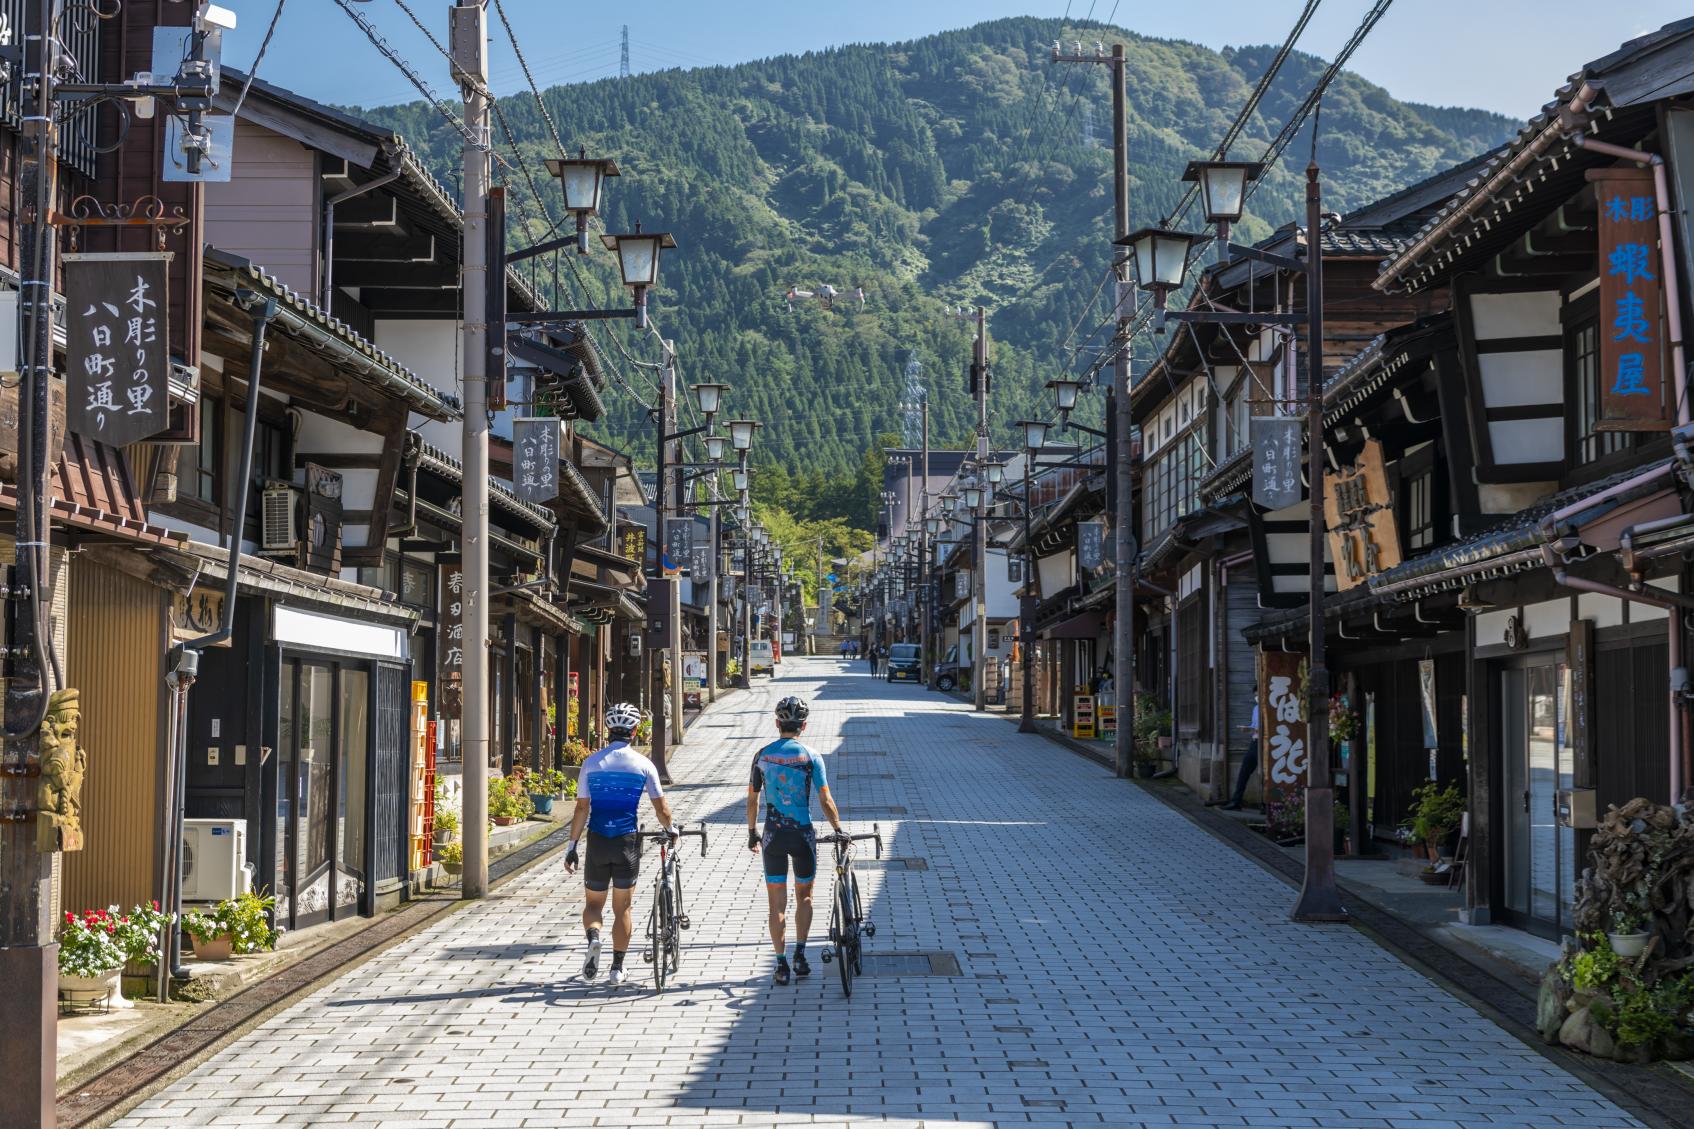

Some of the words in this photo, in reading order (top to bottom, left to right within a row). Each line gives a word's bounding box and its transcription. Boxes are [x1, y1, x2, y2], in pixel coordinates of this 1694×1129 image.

[1604, 195, 1655, 222] 木彫
[124, 274, 156, 415] 木彫りの里
[1607, 242, 1656, 395] 蝦夷屋
[82, 301, 124, 432] 八日町通り
[520, 436, 540, 496] 八日町通り
[538, 425, 554, 489] 木彫りの里
[1261, 438, 1281, 500] 八日町通り
[1282, 426, 1297, 494] 木彫りの里
